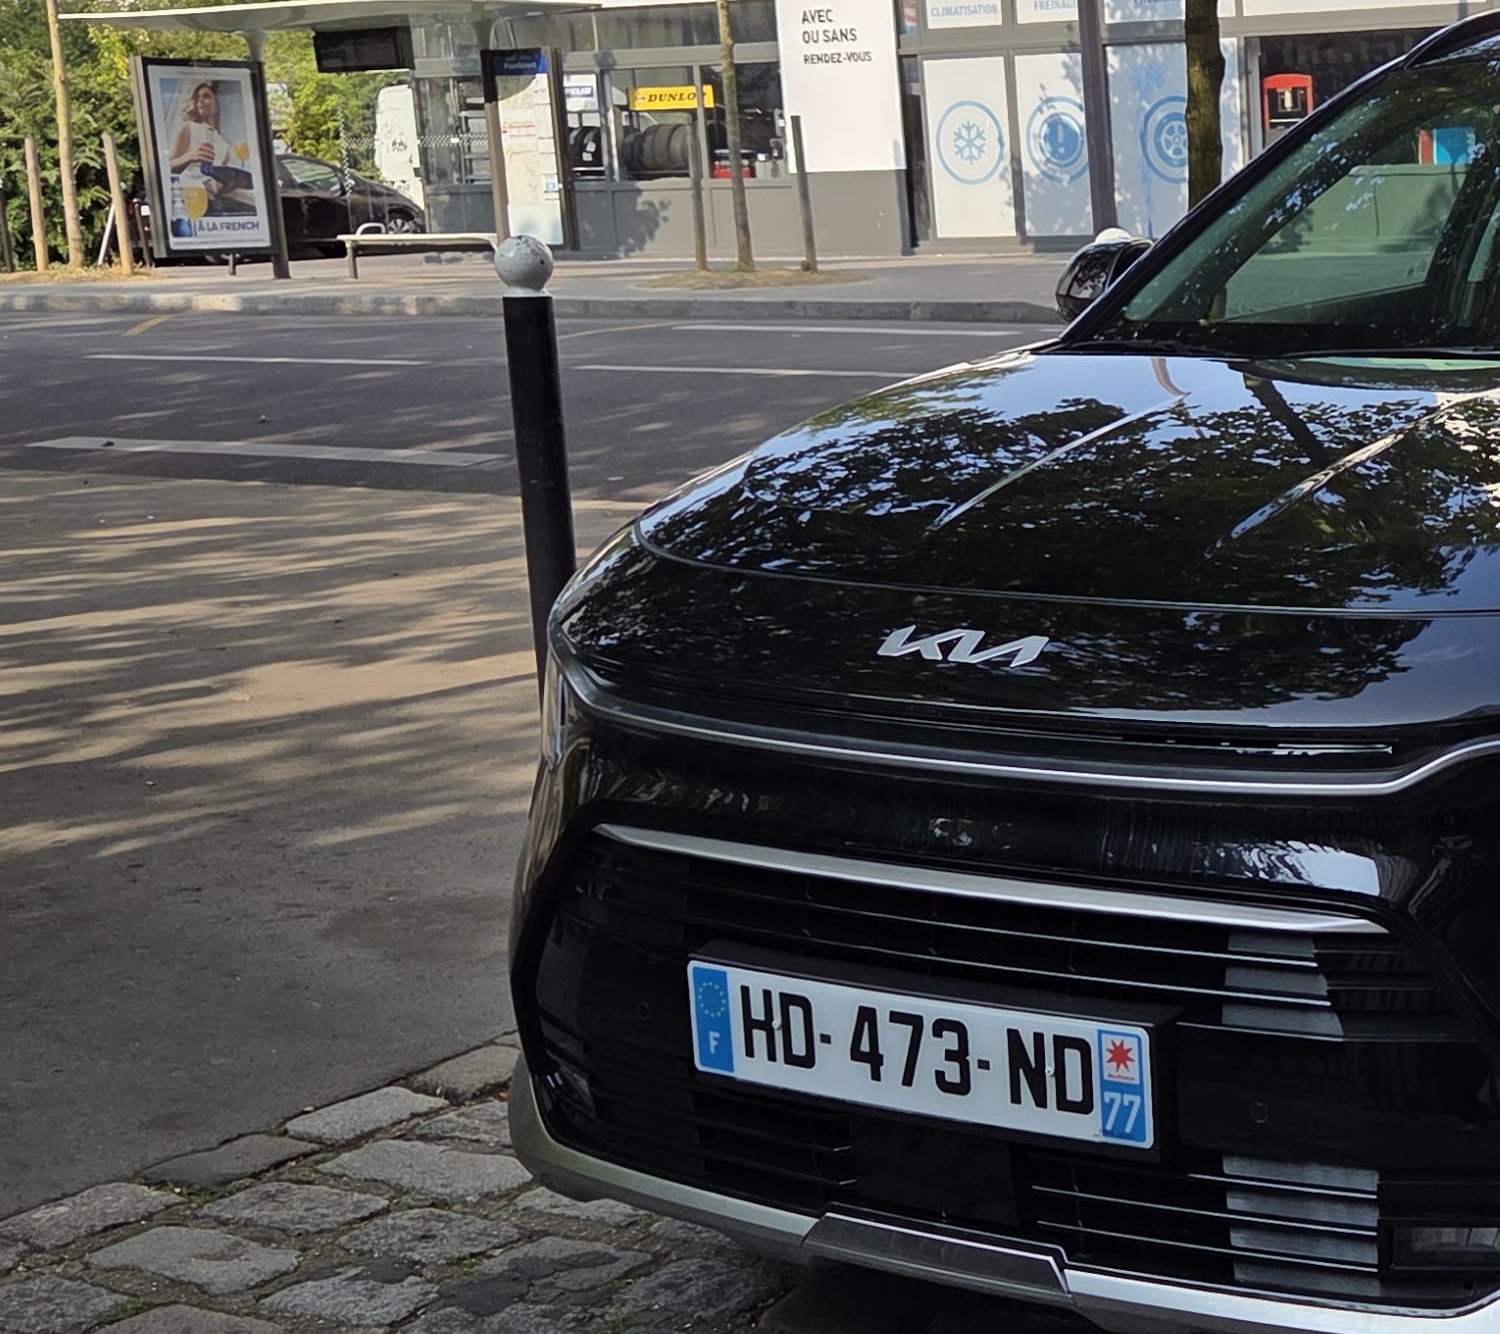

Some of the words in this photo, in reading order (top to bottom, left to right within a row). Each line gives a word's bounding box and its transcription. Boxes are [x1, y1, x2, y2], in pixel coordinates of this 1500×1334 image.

[801, 9, 834, 25] AVEC
[931, 3, 998, 18] CLIMATISATION
[802, 30, 819, 44] OU
[823, 28, 857, 42] SANS
[803, 51, 872, 65] RENDEZ-VOUS
[647, 91, 706, 103] DUNLO
[220, 221, 260, 231] FRENCH
[877, 625, 1050, 668] KIA
[708, 1031, 720, 1055] F
[740, 984, 1095, 1117] HD-473-ND
[1103, 1090, 1142, 1134] 77
